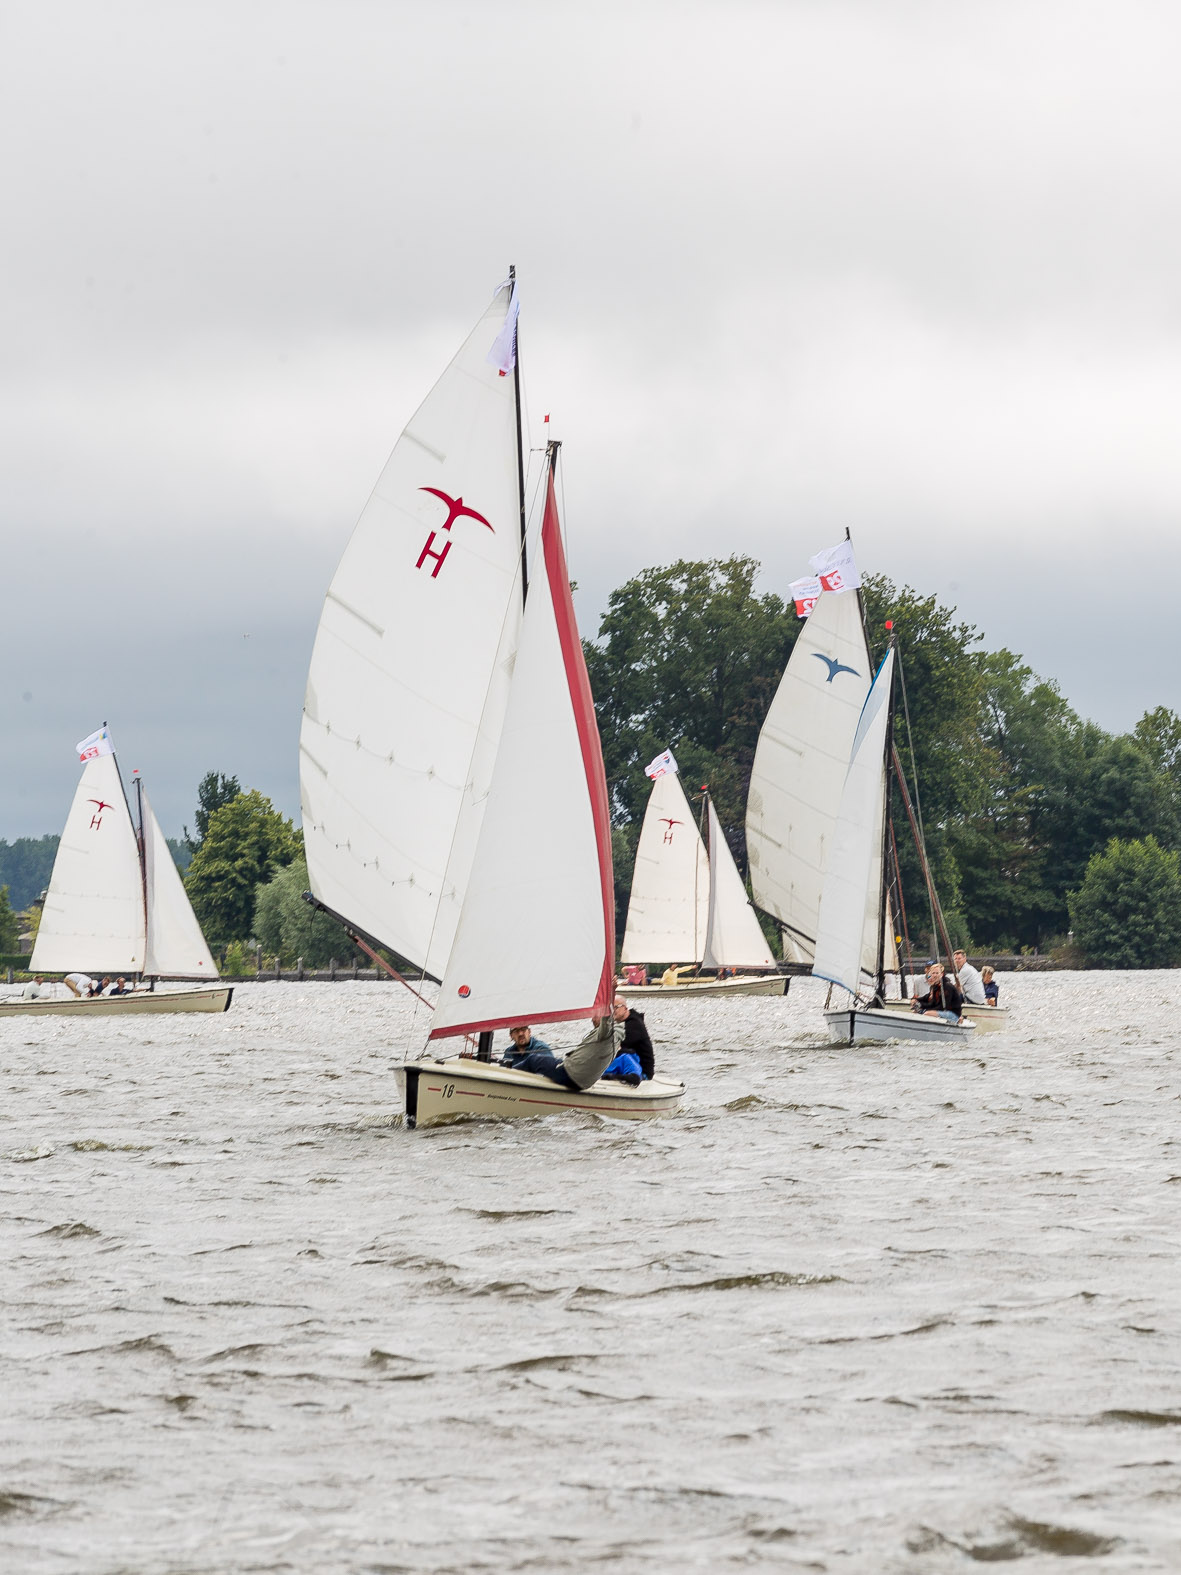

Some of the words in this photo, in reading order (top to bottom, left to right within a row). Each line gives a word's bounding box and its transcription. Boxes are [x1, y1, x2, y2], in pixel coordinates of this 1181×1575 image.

[415, 530, 452, 579] H
[89, 814, 102, 831] H
[663, 831, 673, 845] H
[441, 1083, 455, 1099] 16
